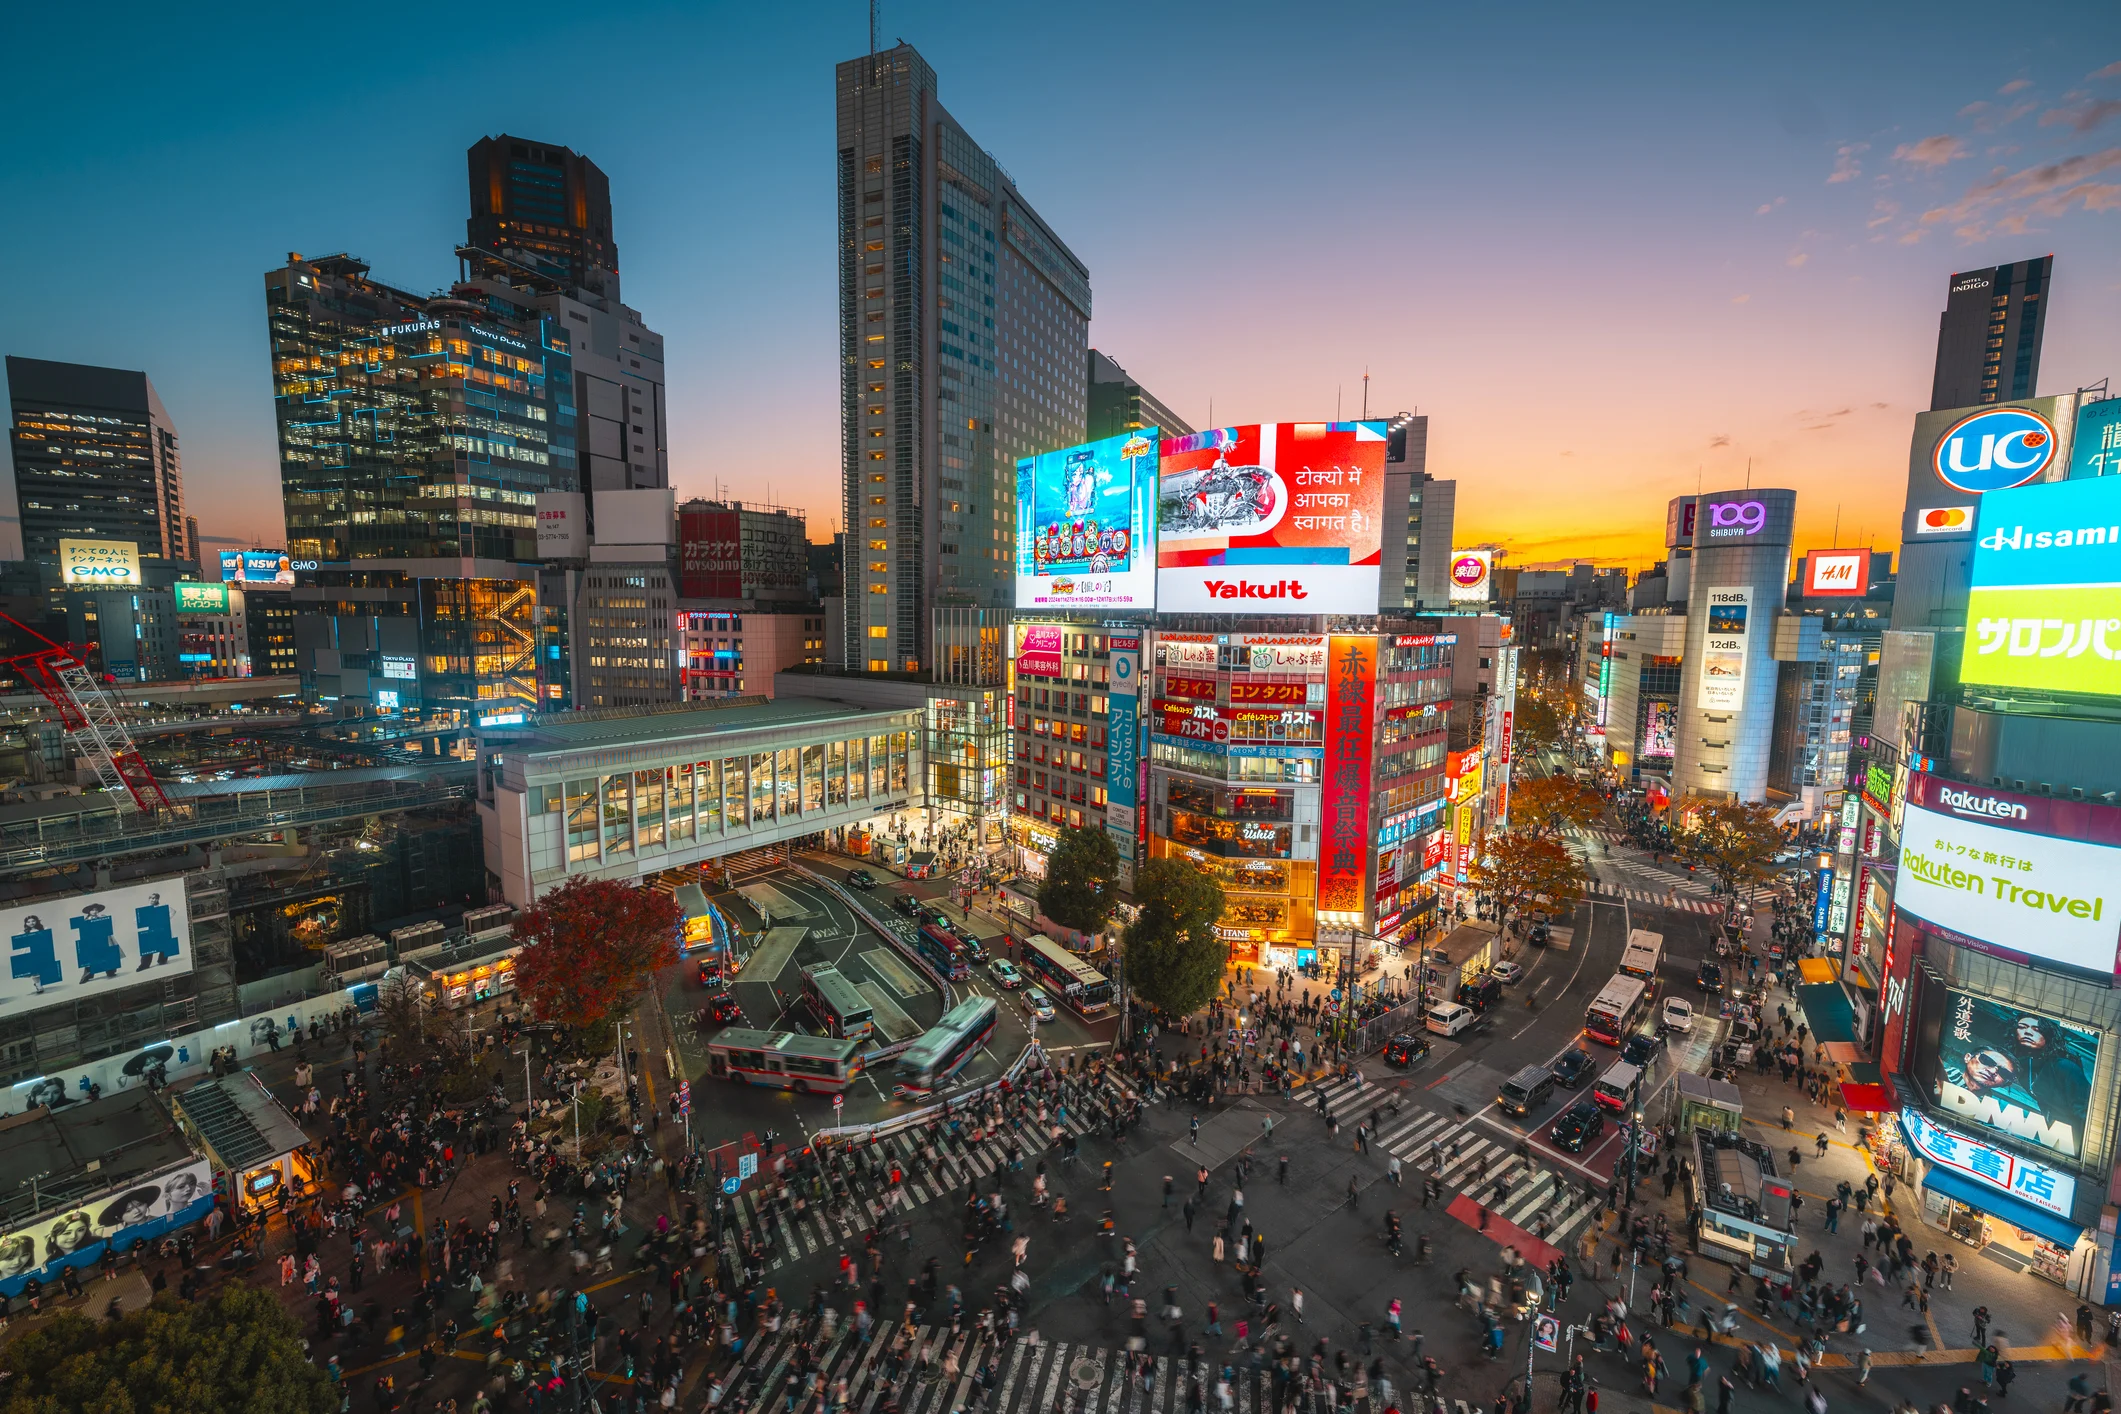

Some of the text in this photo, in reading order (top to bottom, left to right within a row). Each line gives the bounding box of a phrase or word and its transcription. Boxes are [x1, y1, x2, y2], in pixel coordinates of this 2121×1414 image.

[1952, 280, 1989, 293] INDIGO
[1961, 278, 1982, 286] HOTEL
[392, 320, 440, 334] FUKURAS
[470, 326, 527, 350] TOKYU PLAZA
[1295, 466, 1362, 486] टोक्यो में
[1294, 493, 1350, 508] आपका
[539, 511, 566, 520] 広告募集
[1710, 502, 1766, 535] 109
[1293, 516, 1346, 530] स्वागत
[1710, 528, 1744, 536] SHIBUYA
[70, 547, 129, 556] すべての人に
[684, 540, 738, 558] カラオケ
[70, 556, 129, 564] インターネット
[223, 559, 236, 567] NSW
[248, 559, 277, 568] NSW
[291, 560, 318, 570] GMO
[684, 559, 740, 571] JOYSOUND
[72, 566, 130, 576] GMO
[1455, 566, 1481, 577] 楽園
[1820, 564, 1852, 581] H&M
[182, 587, 222, 601] 東進
[1204, 580, 1308, 599] Yakult
[1035, 631, 1059, 639] 品川スキン
[1243, 635, 1323, 645] しゃぶしゃぶバイキング
[1036, 640, 1057, 648] クリニック
[1157, 650, 1166, 658] 9F
[1184, 646, 1215, 663] しゃぶ葉
[1276, 650, 1324, 666] しゃぶ葉
[1023, 659, 1059, 672] 品川美容外科
[1112, 680, 1134, 690] eyecity
[1167, 679, 1215, 695] プライス
[1232, 685, 1304, 699] コンタクト
[1193, 705, 1218, 720] ガスト
[1281, 711, 1315, 724] ガスト
[1154, 717, 1165, 727] 7F
[1181, 720, 1210, 736] ガスト
[1112, 708, 1123, 786] アイシティ
[1124, 710, 1132, 789] コンタクトの
[1330, 646, 1368, 876] 赤線最狂爆音祭典
[1112, 806, 1128, 815] CONTACT
[1940, 787, 2027, 820] Rakuten
[1110, 816, 1131, 826] SPECIALISTS
[1243, 829, 1276, 840] Ushi8
[1378, 826, 1399, 844] AGA
[1935, 839, 2033, 872] おトクな旅行は
[1420, 867, 1437, 885] LUSH
[1903, 848, 2103, 921] Rakuten Travel
[1940, 929, 1989, 951] Rakuten Vision
[1953, 996, 1975, 1043] 外道の歌
[2084, 1027, 2096, 1036] TV
[1940, 1080, 2075, 1156] DMM
